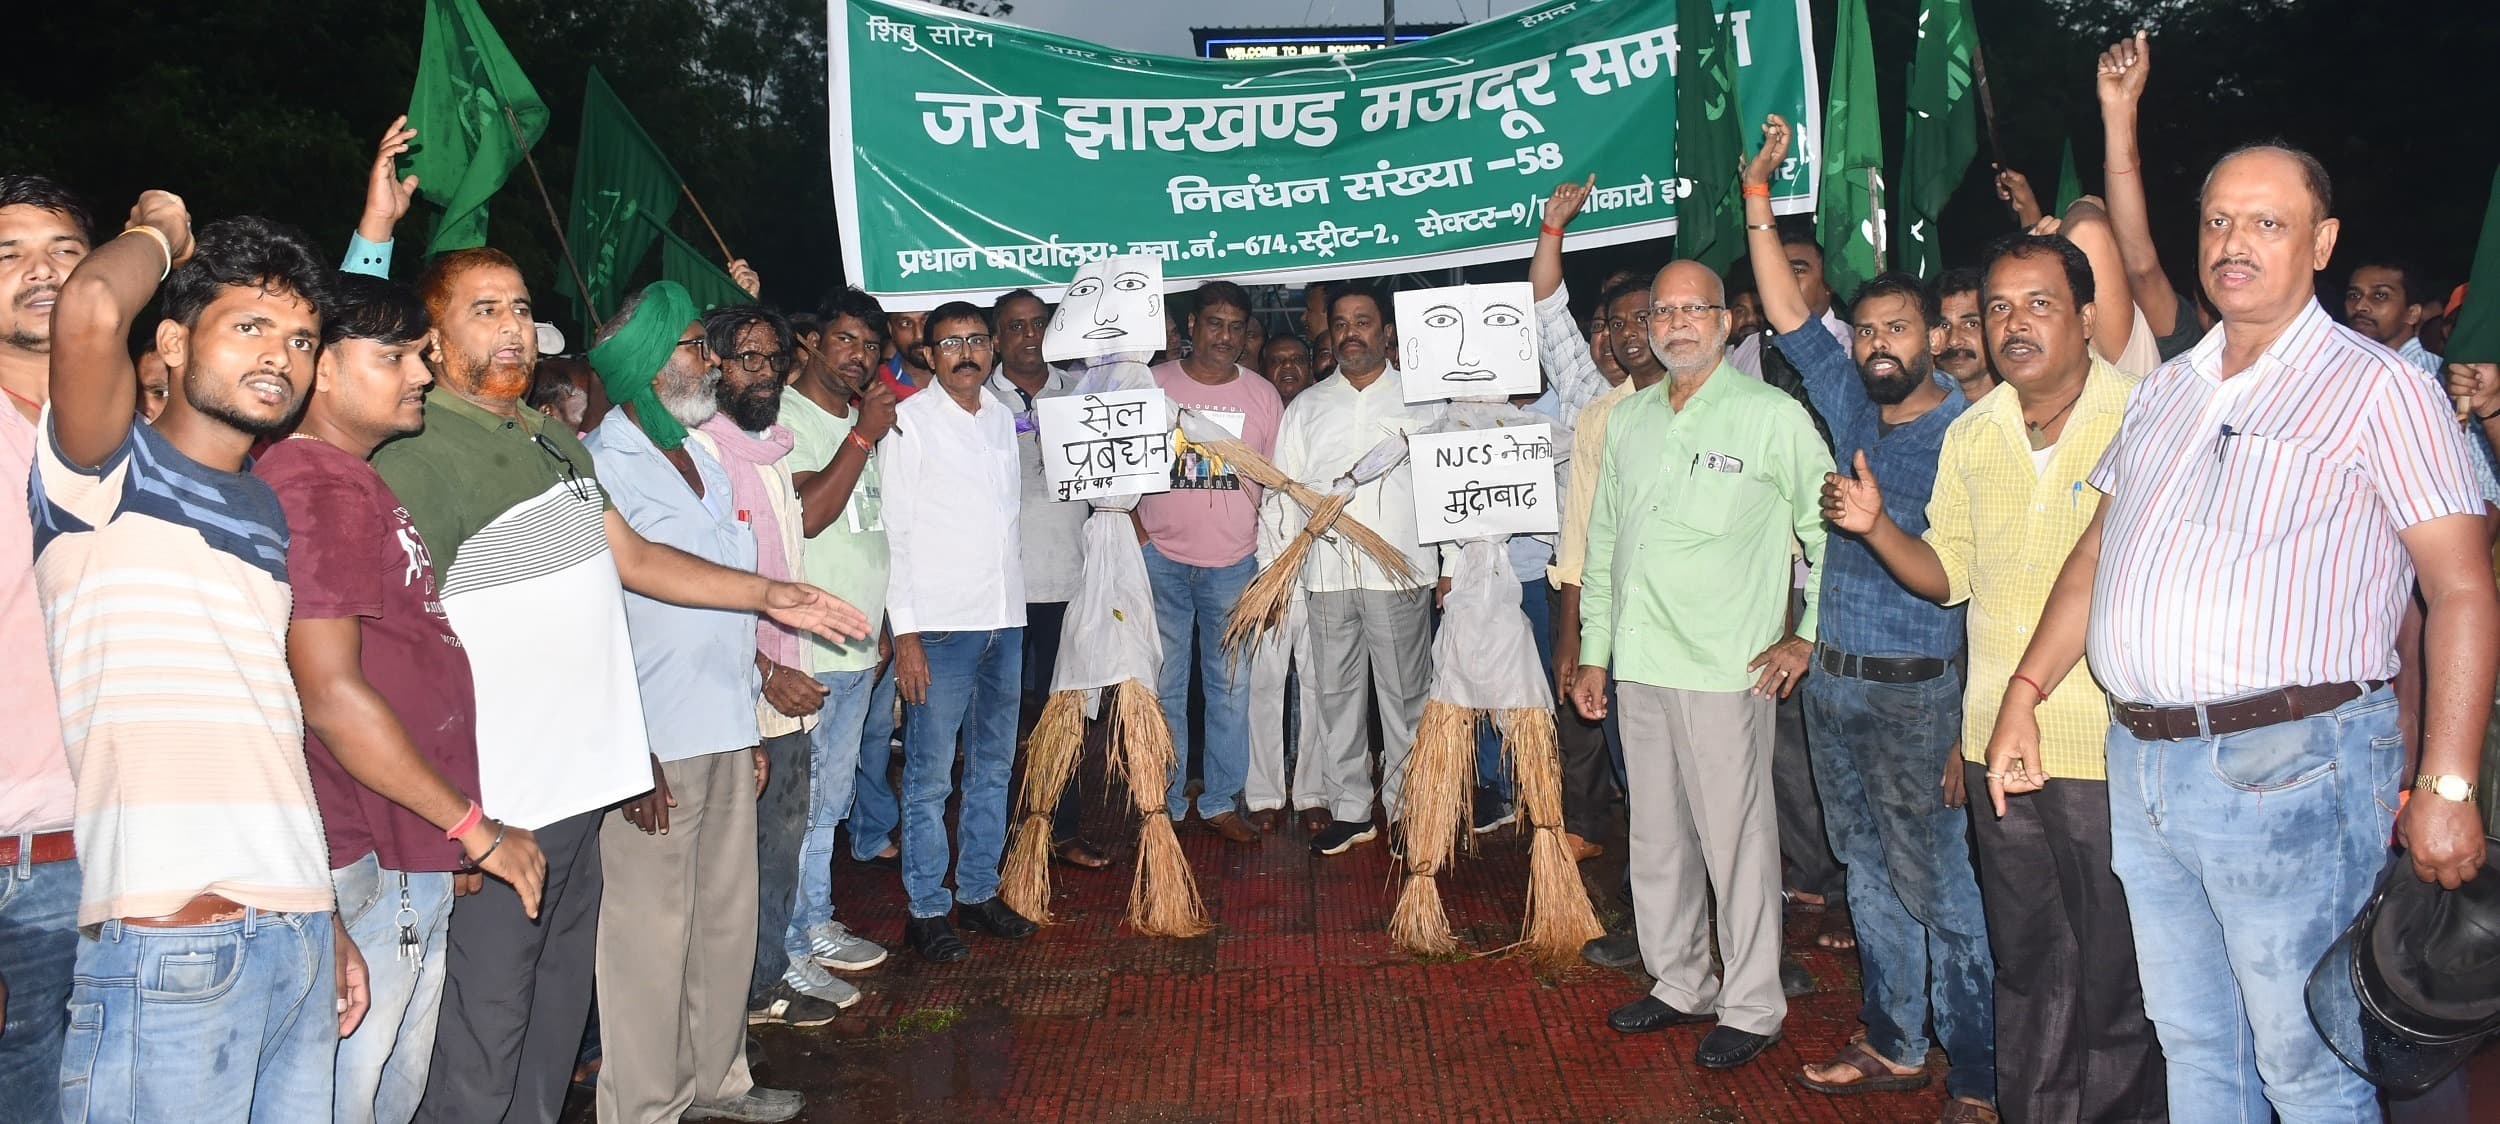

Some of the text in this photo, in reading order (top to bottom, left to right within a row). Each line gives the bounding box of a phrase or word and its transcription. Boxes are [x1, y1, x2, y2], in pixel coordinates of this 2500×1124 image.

[866, 15, 917, 52] शिबु
[1517, 2, 1577, 28] हेमन्त
[1282, 46, 1298, 56] TO
[915, 92, 1042, 149] जय
[1058, 91, 1345, 160] झारखण्ड
[1361, 52, 1558, 139] मजदूर
[1166, 173, 1330, 214] निबंधन
[1340, 159, 1473, 200] संख्या
[897, 247, 977, 279] प्रधान
[1080, 394, 1147, 434] सेल
[1178, 403, 1244, 412] OLOURFUL
[1443, 480, 1538, 524] मुर्दाबाद
